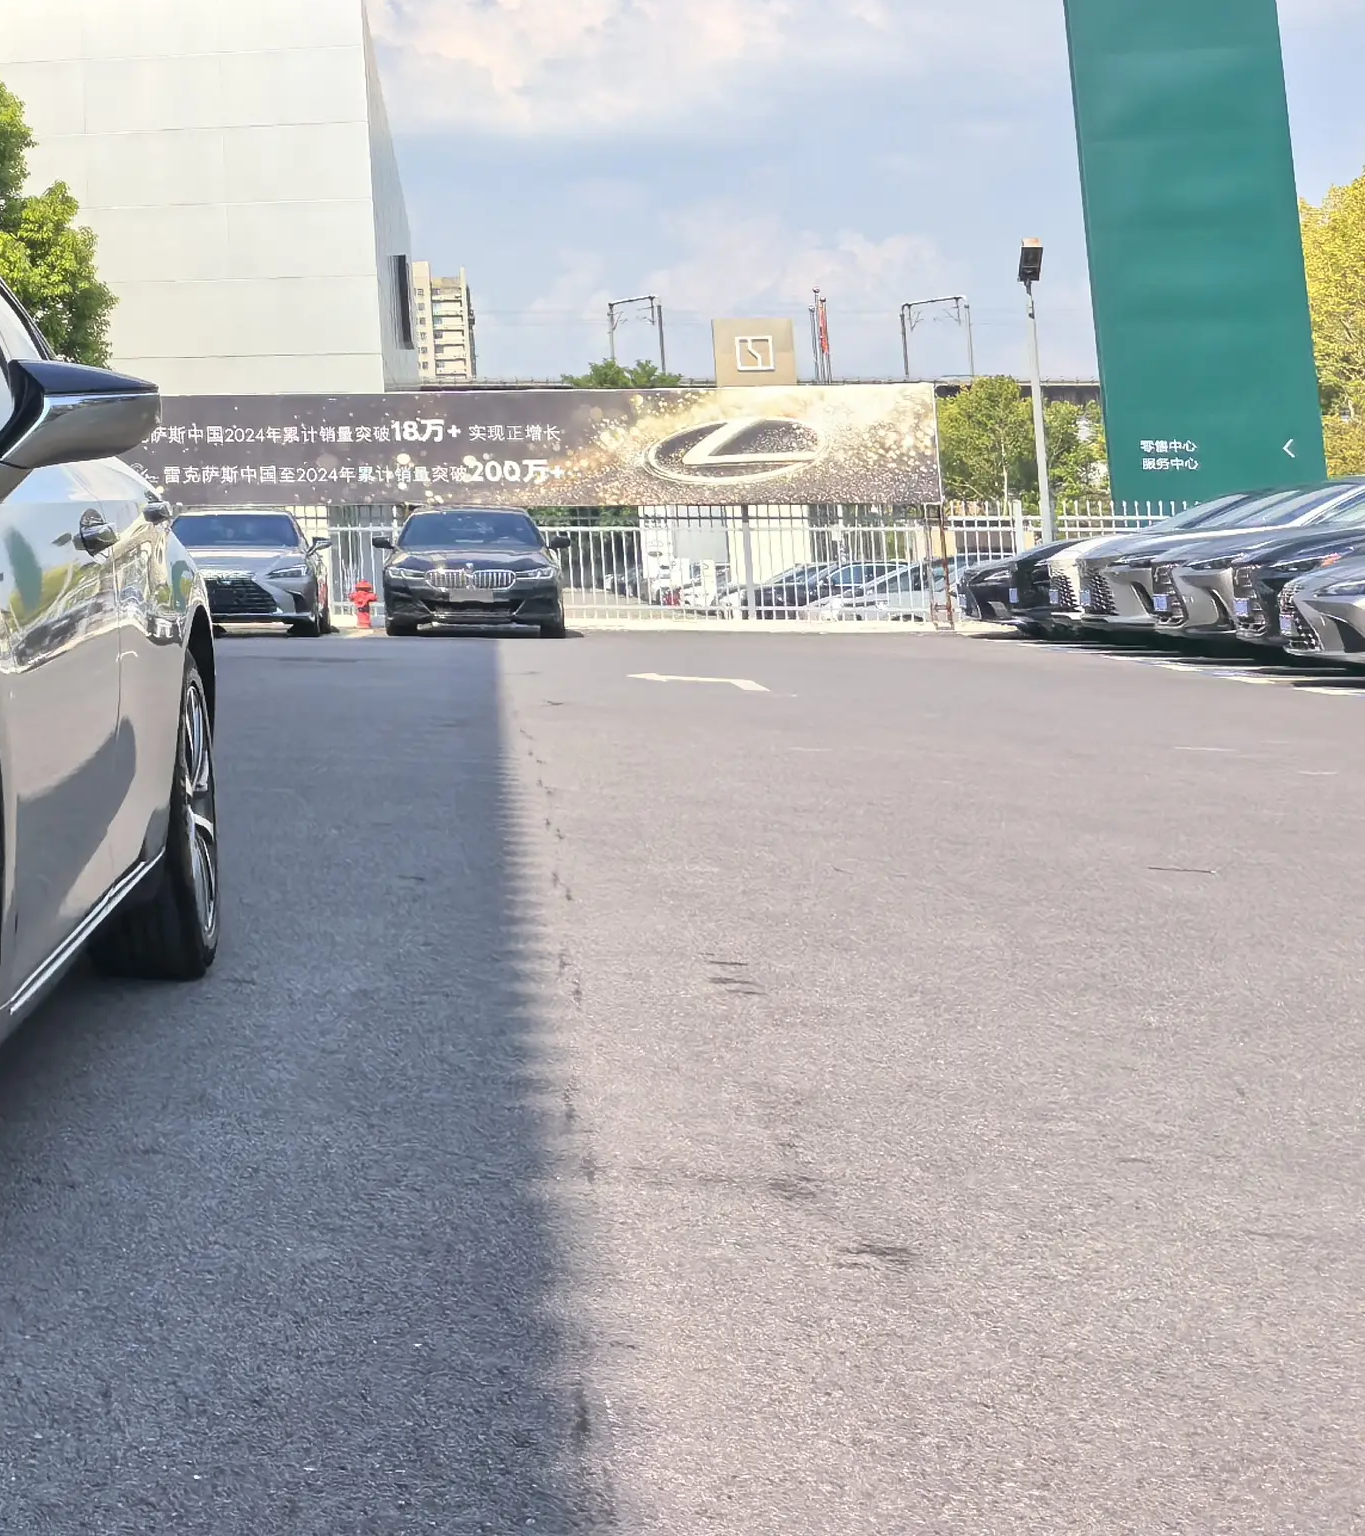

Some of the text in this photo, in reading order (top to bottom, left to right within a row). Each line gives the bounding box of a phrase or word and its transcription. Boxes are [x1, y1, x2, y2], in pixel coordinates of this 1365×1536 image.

[142, 419, 561, 445] 萨斯中国2024年累计销量突破18万+ 实现正增长
[164, 459, 564, 485] 雷克萨斯中国至2024年累计销量突破200万+
[1142, 457, 1199, 471] 服务中心
